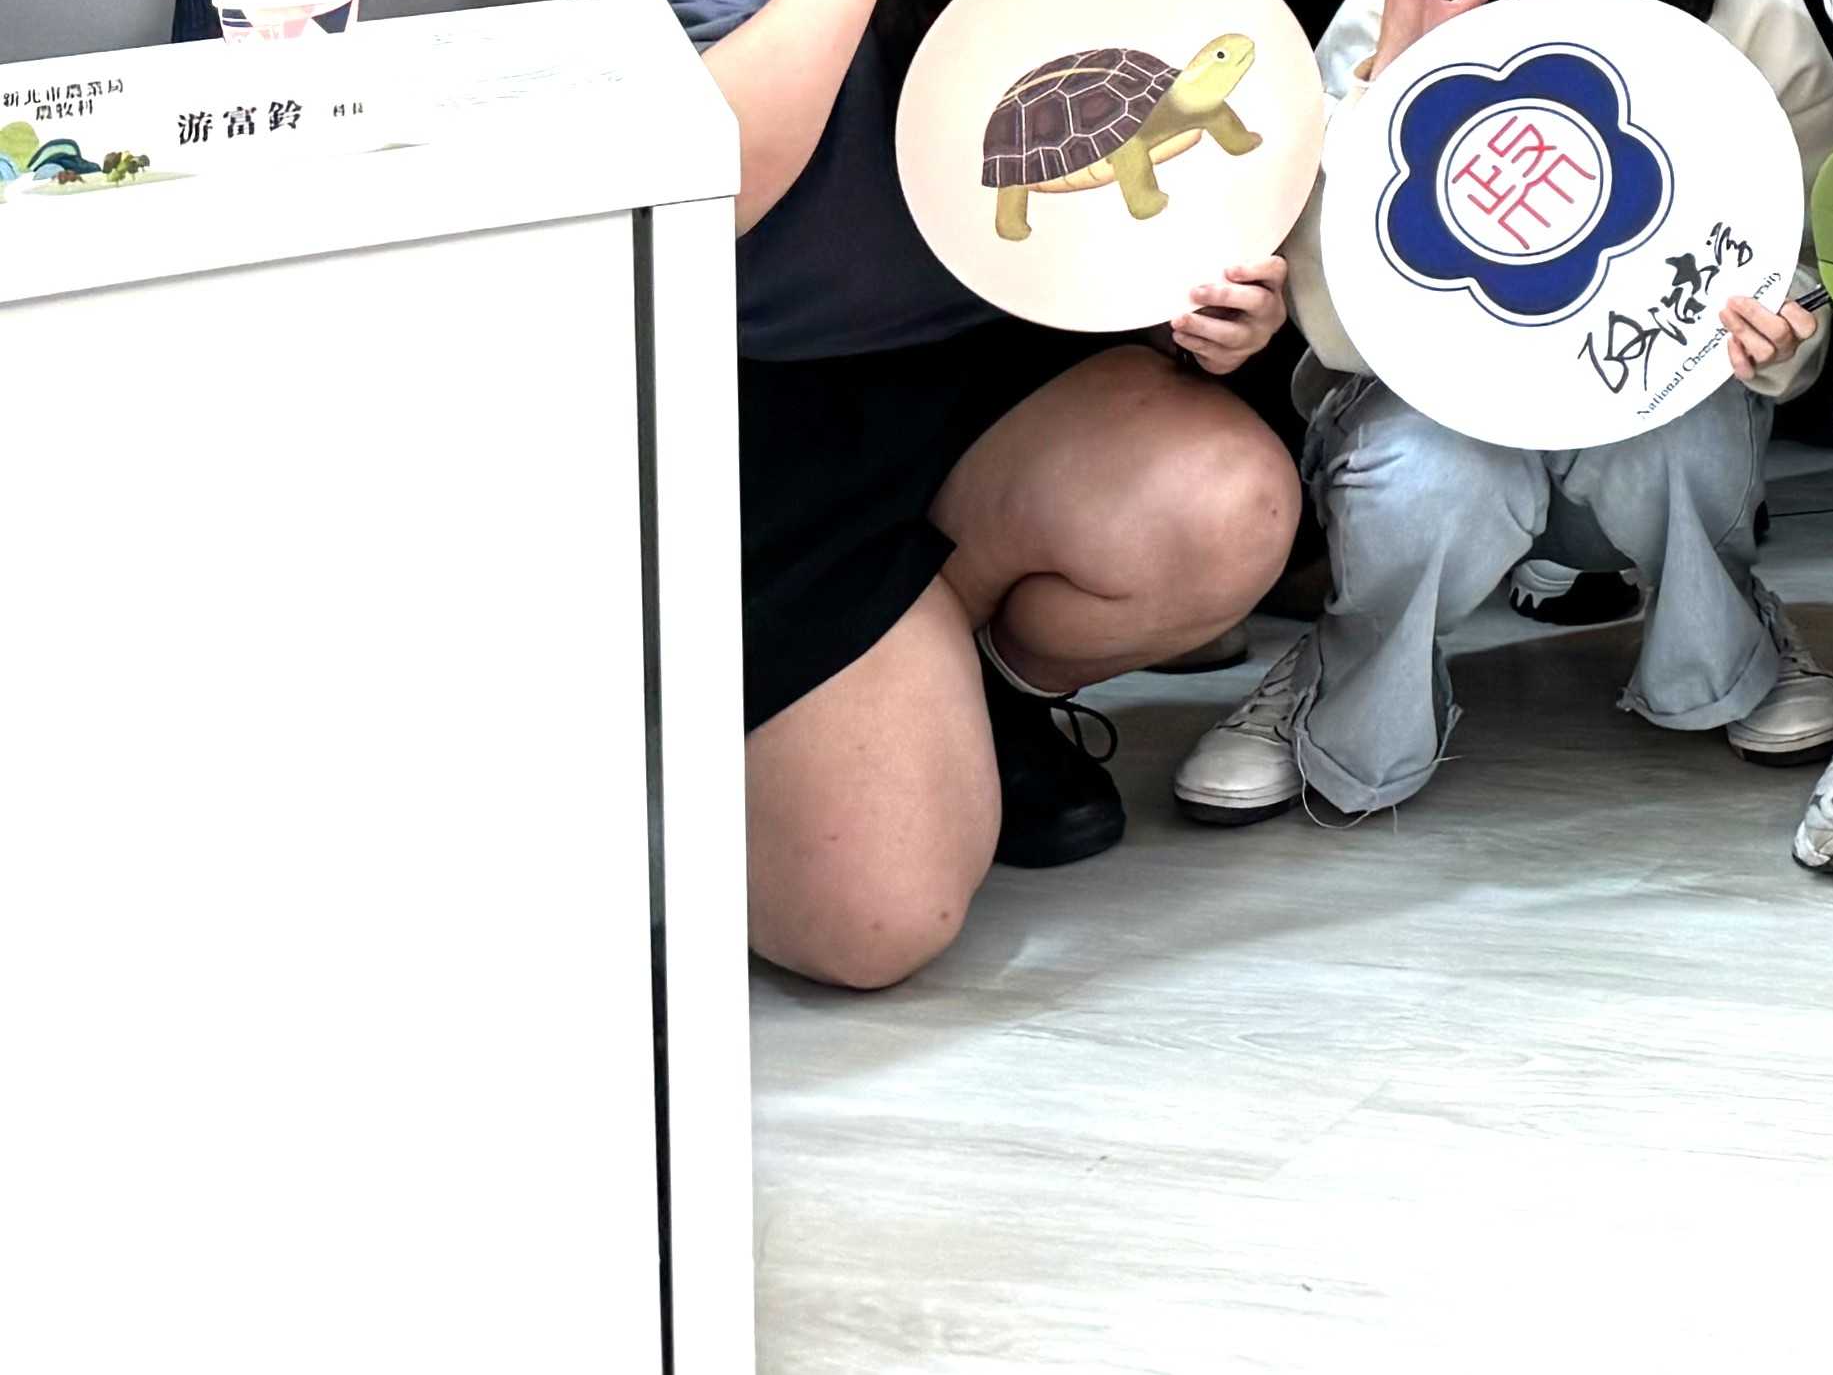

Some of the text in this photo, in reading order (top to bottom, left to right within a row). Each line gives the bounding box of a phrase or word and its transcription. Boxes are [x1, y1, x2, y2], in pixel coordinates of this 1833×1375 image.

[178, 99, 303, 145] 游富鈴
[1681, 321, 1729, 373] Chengch
